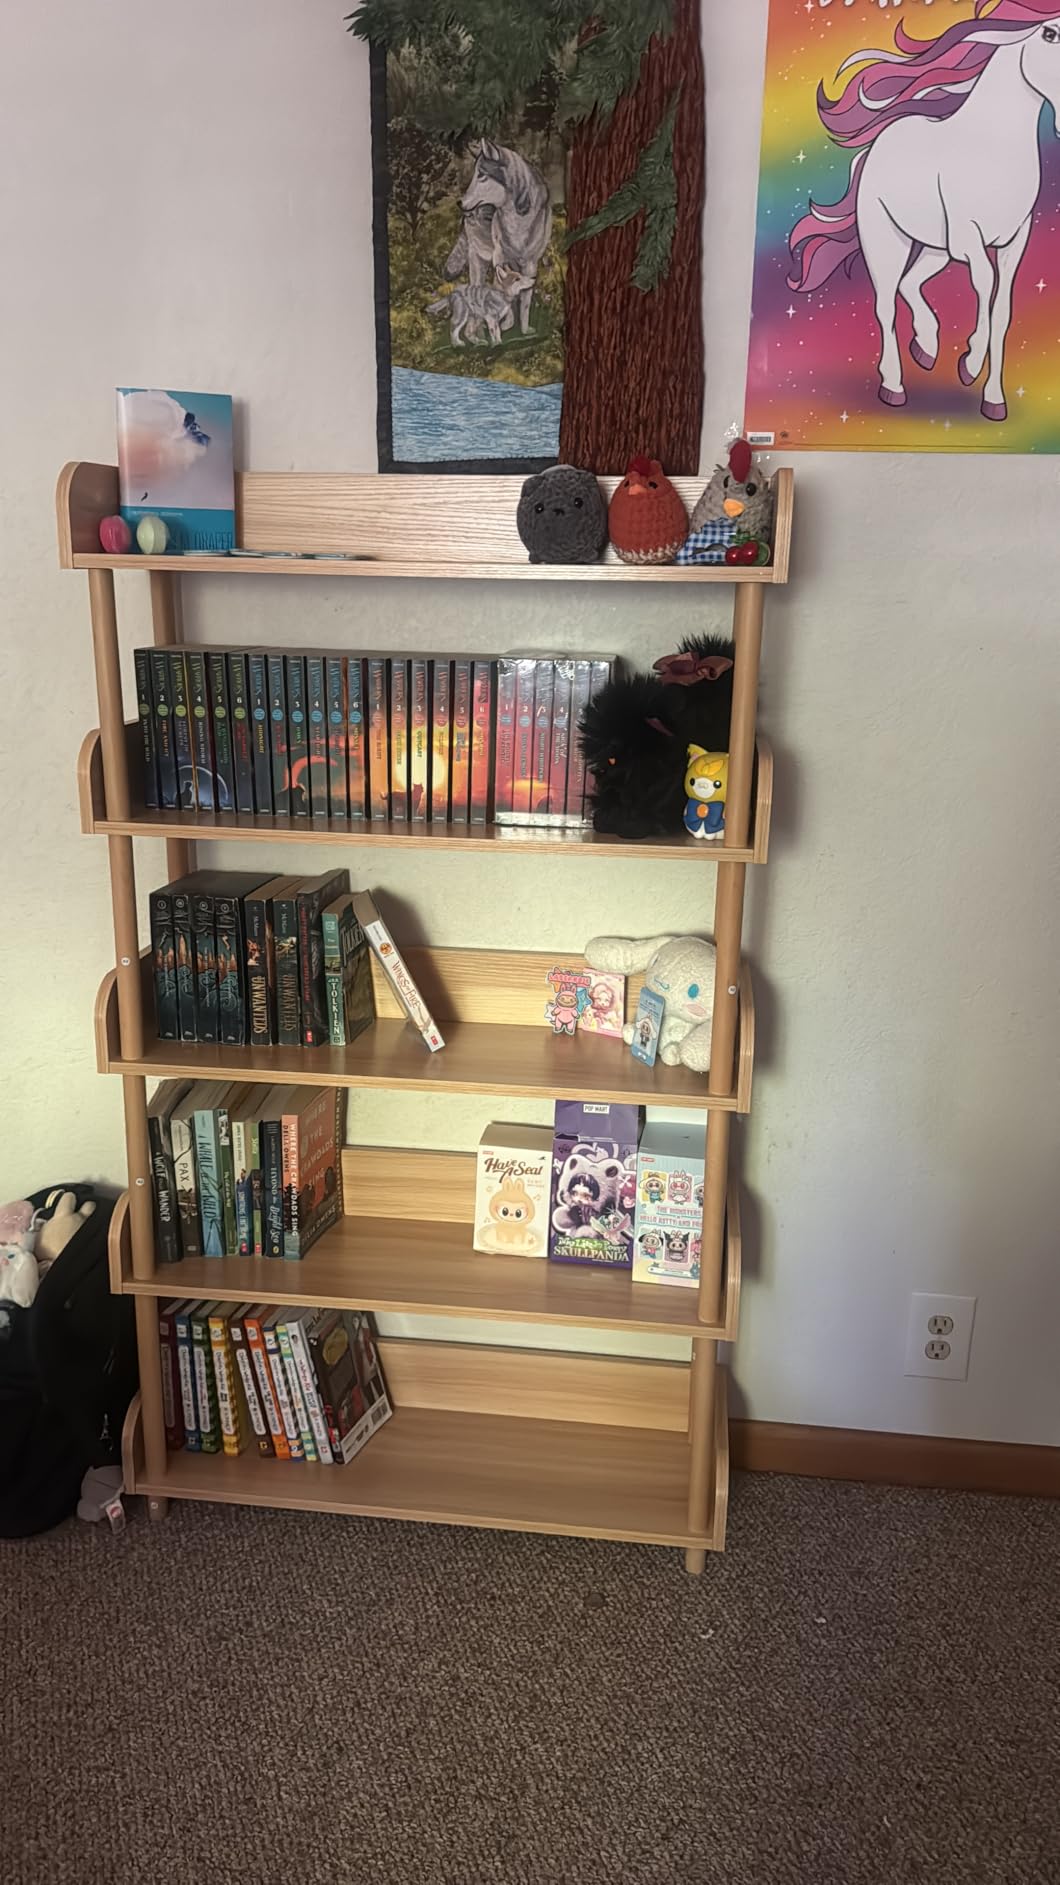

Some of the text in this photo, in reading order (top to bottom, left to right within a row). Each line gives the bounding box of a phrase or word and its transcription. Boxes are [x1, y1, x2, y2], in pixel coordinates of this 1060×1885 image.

[392, 960, 409, 987] WINGS
[407, 989, 421, 1008] FIRE
[251, 976, 267, 1034] UNWANTEDS
[282, 974, 296, 1032] UNWANTEDS
[331, 983, 341, 1034] TOLKIEN
[154, 1157, 167, 1178] WOLF
[198, 1142, 212, 1171] WHALE
[484, 1158, 517, 1172] Have
[178, 1163, 189, 1182] PAX
[513, 1161, 543, 1176] Seat
[158, 1190, 171, 1222] WANDER
[203, 1195, 216, 1218] WILD
[269, 1206, 281, 1229] Bright
[269, 1230, 279, 1243] Sea
[554, 1246, 629, 1261] SKULLPANDA
